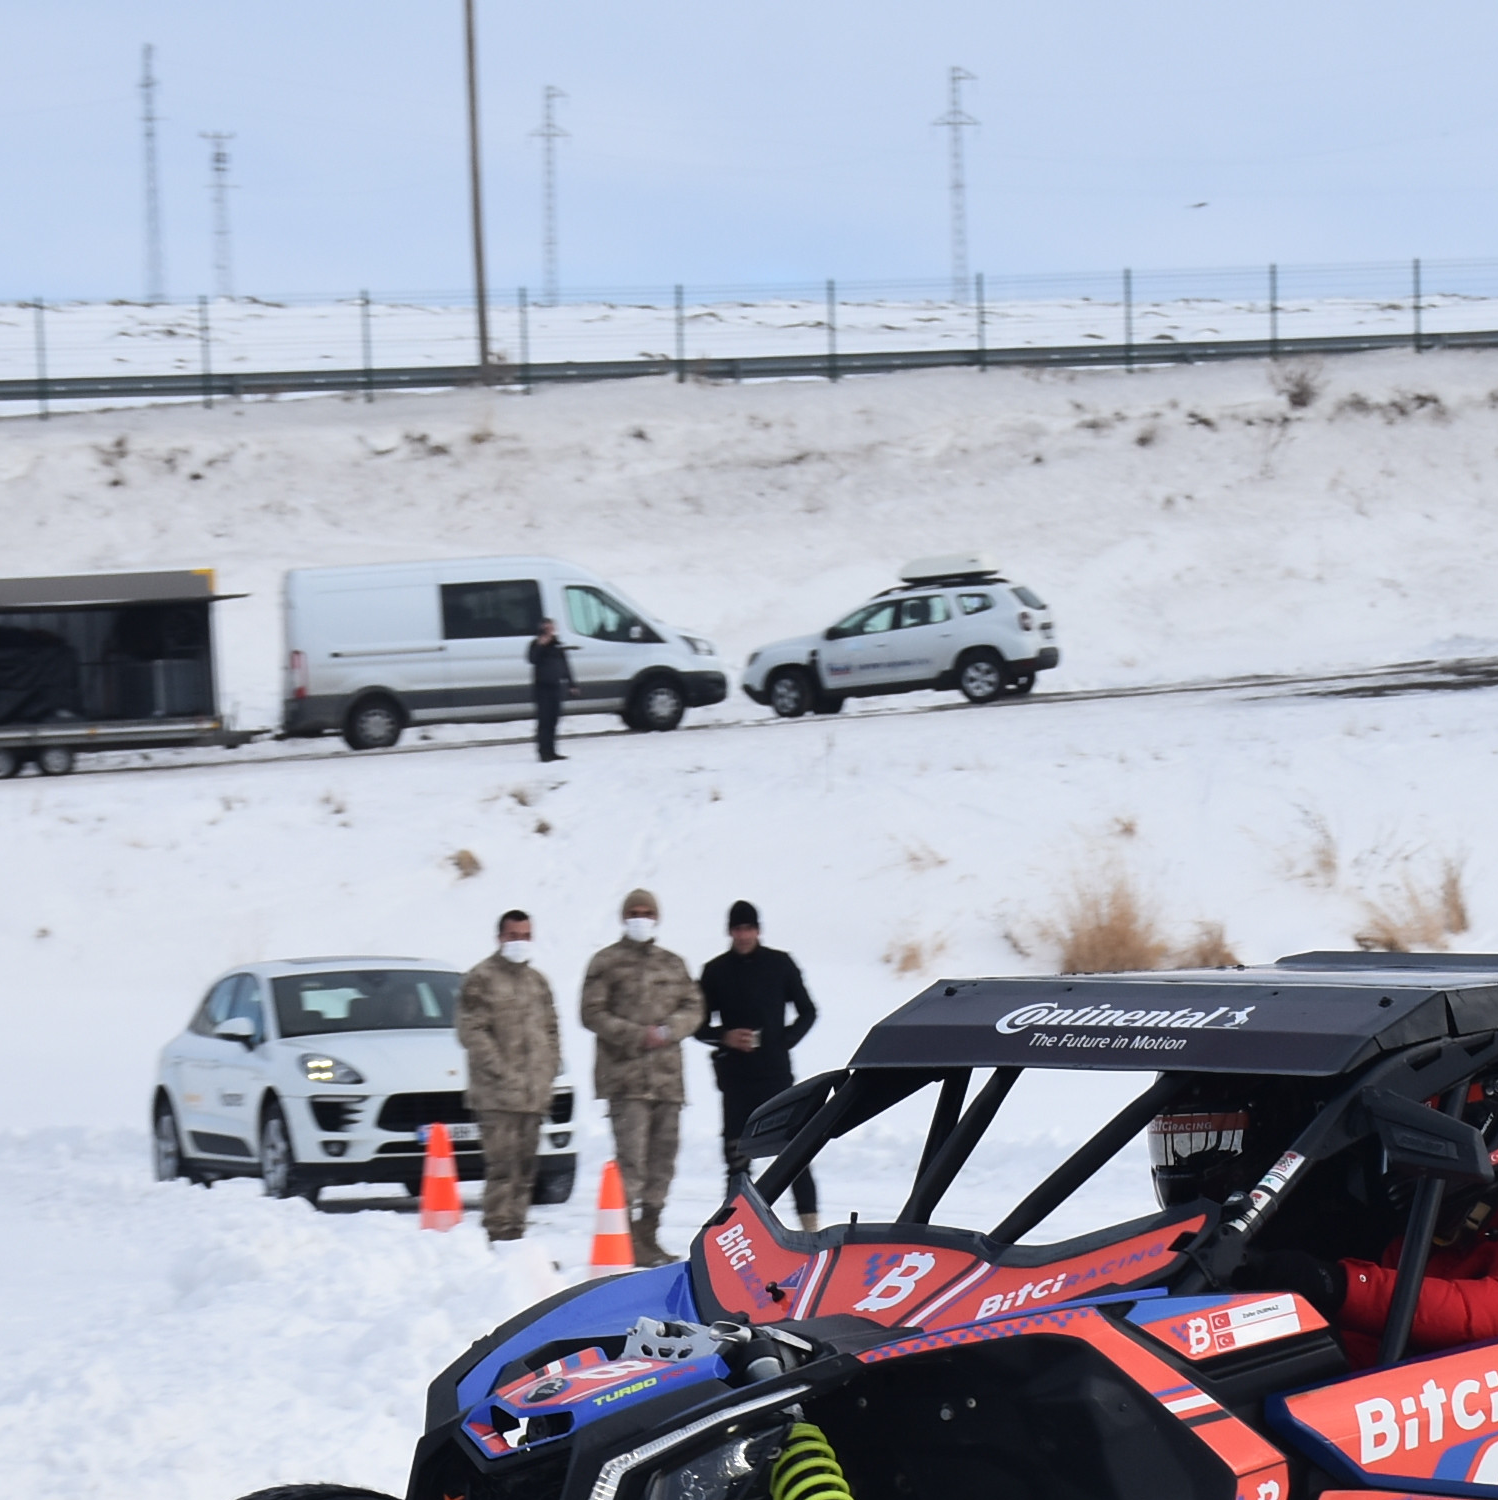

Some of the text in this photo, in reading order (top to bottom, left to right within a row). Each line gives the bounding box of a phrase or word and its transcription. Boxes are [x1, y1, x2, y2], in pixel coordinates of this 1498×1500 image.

[995, 1002, 1232, 1034] Continental
[1029, 1032, 1187, 1050] The Future in Motion
[1063, 1242, 1167, 1289] RACING
[592, 1377, 659, 1406] TURBO
